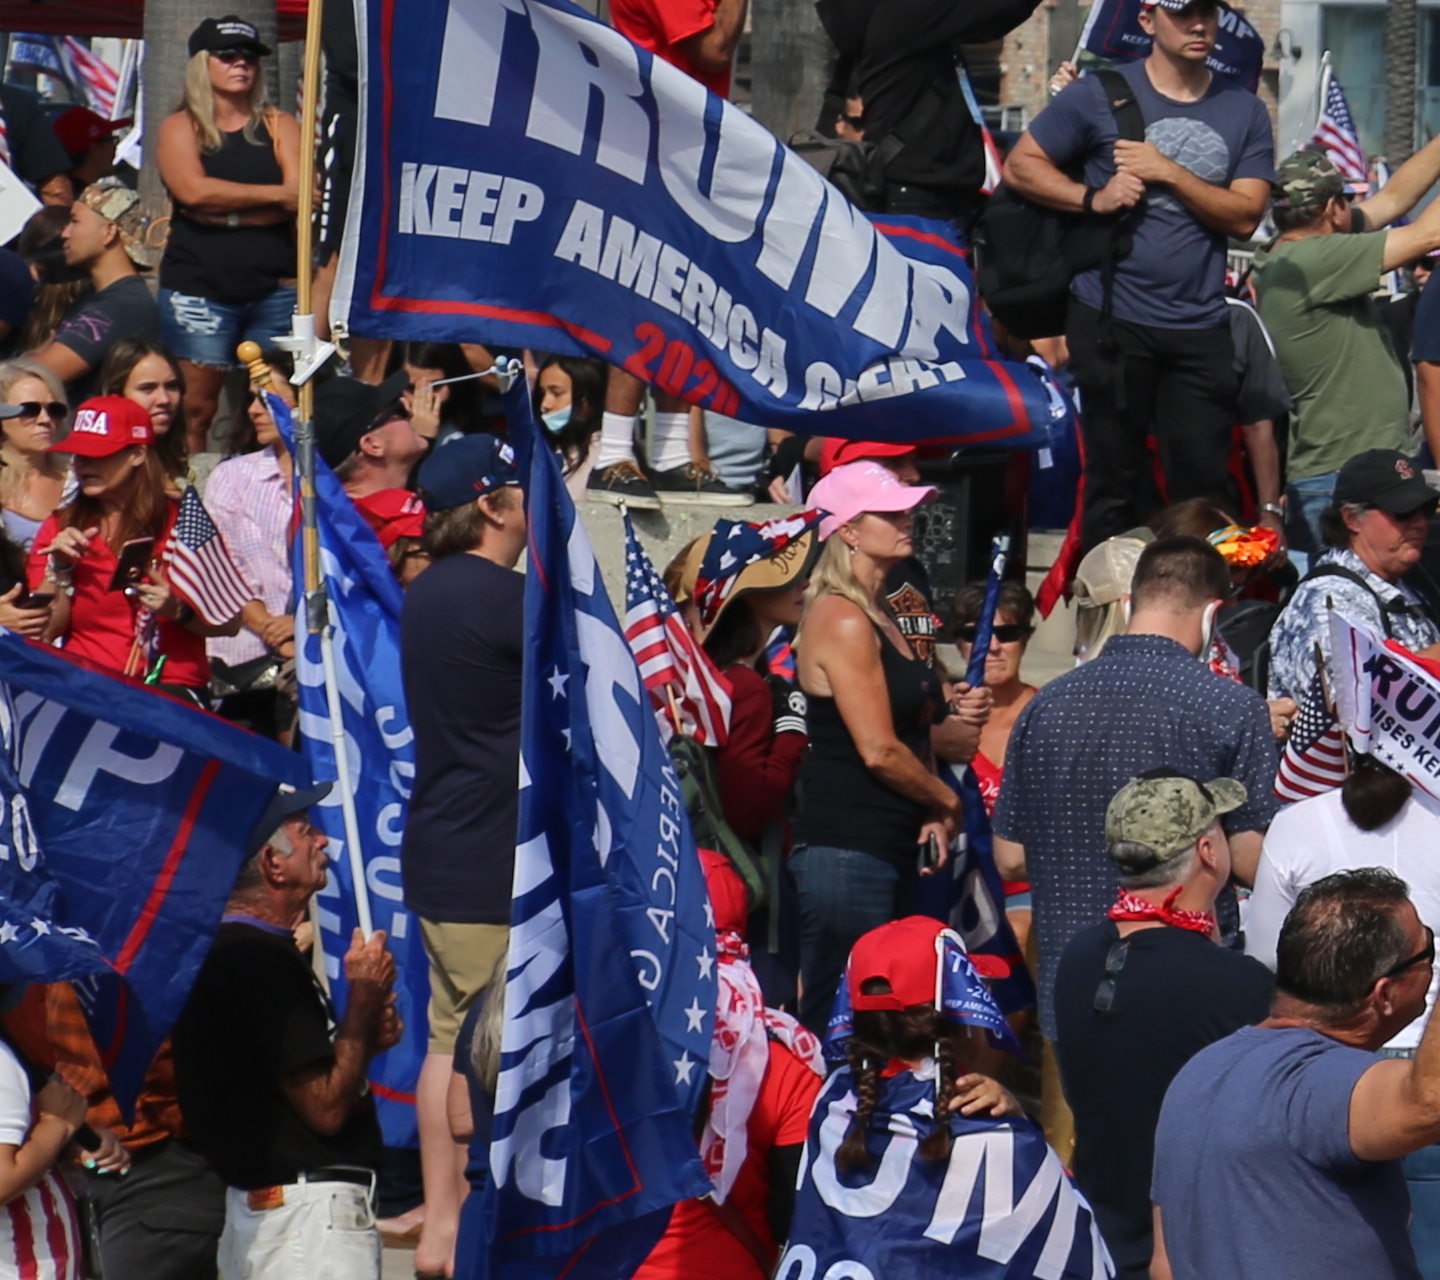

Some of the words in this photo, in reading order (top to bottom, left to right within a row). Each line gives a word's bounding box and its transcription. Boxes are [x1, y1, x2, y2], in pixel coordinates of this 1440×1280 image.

[398, 162, 546, 246] KEEP
[553, 198, 788, 399] AMERICA
[73, 409, 109, 435] USA
[1370, 701, 1416, 750] MISES
